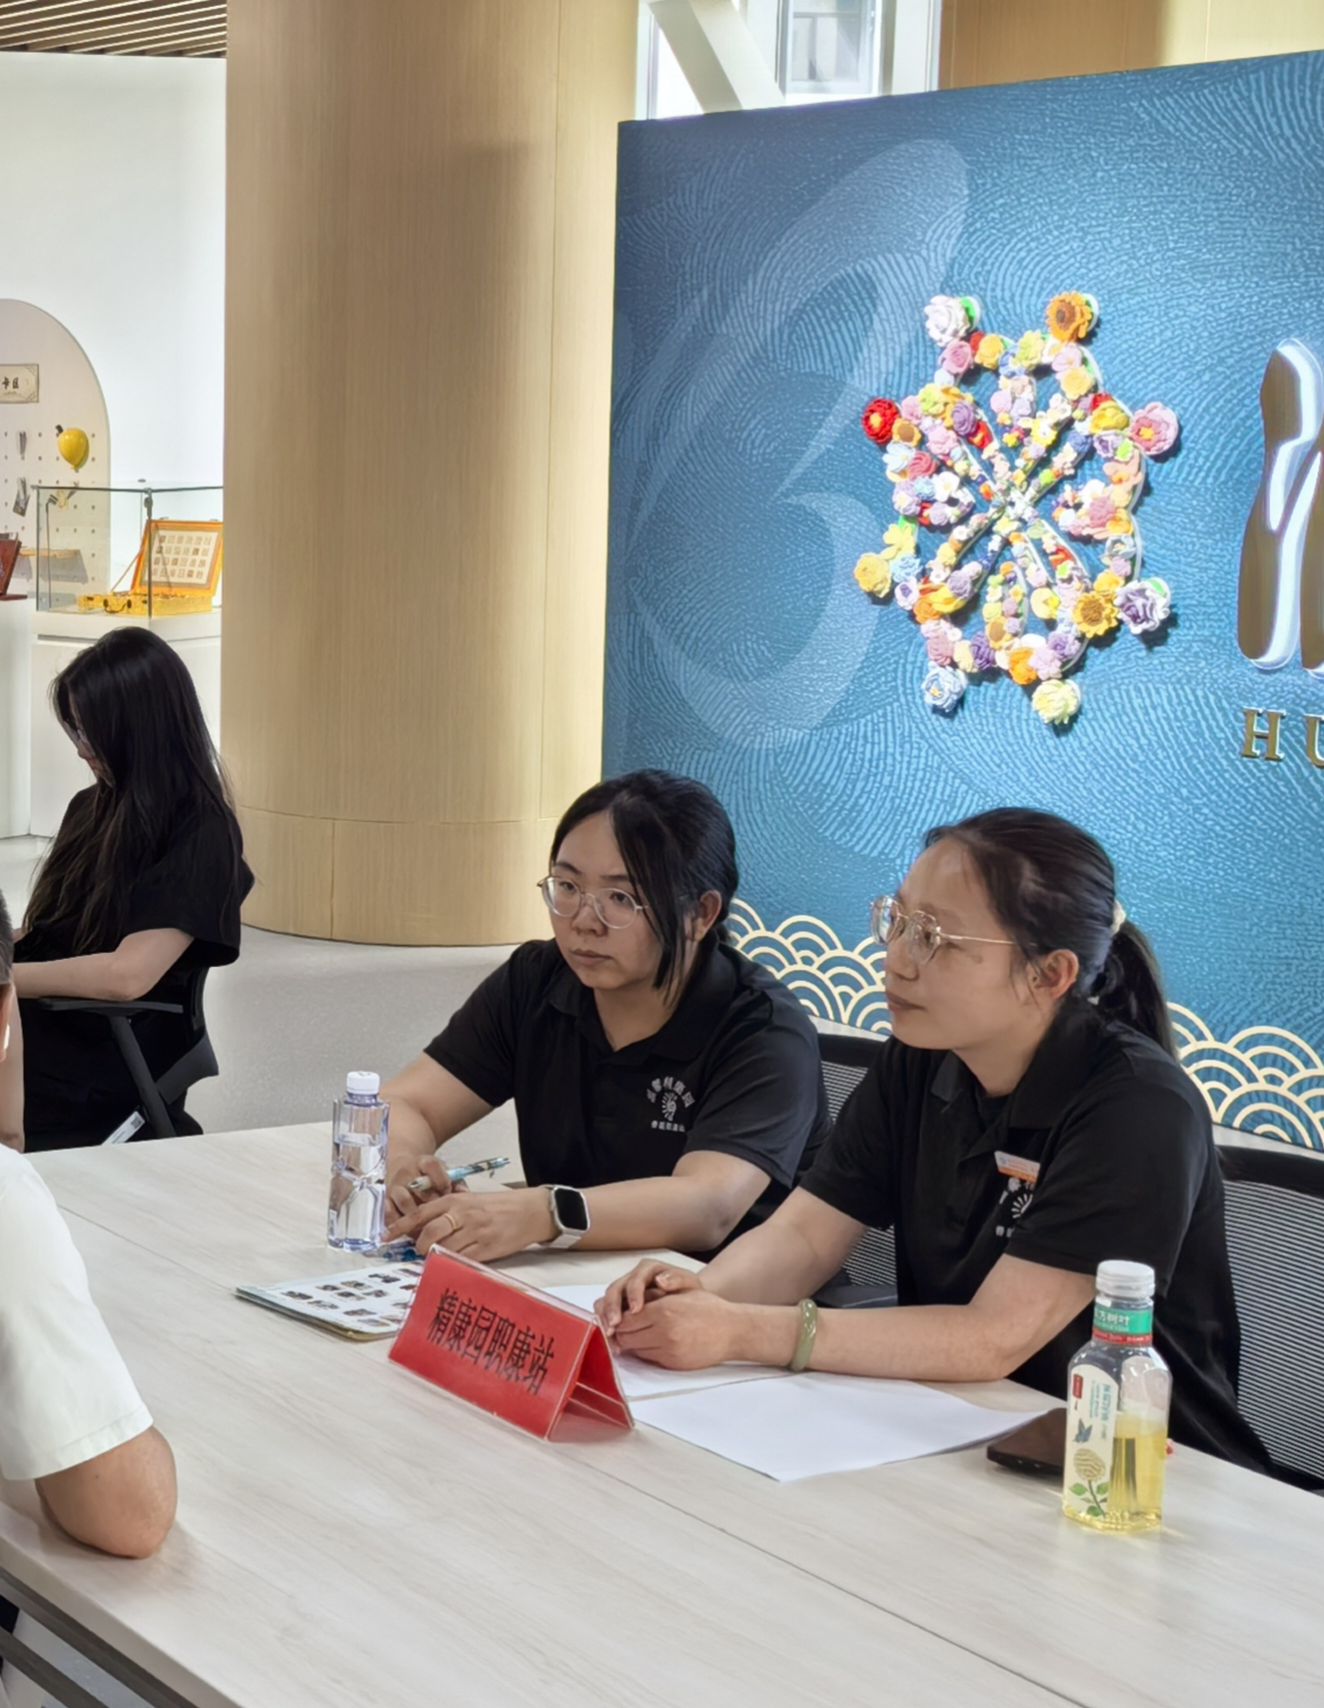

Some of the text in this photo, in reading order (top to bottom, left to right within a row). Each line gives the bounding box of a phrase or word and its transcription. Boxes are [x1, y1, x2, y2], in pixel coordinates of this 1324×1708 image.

[427, 1288, 555, 1395] 精康园职康站
